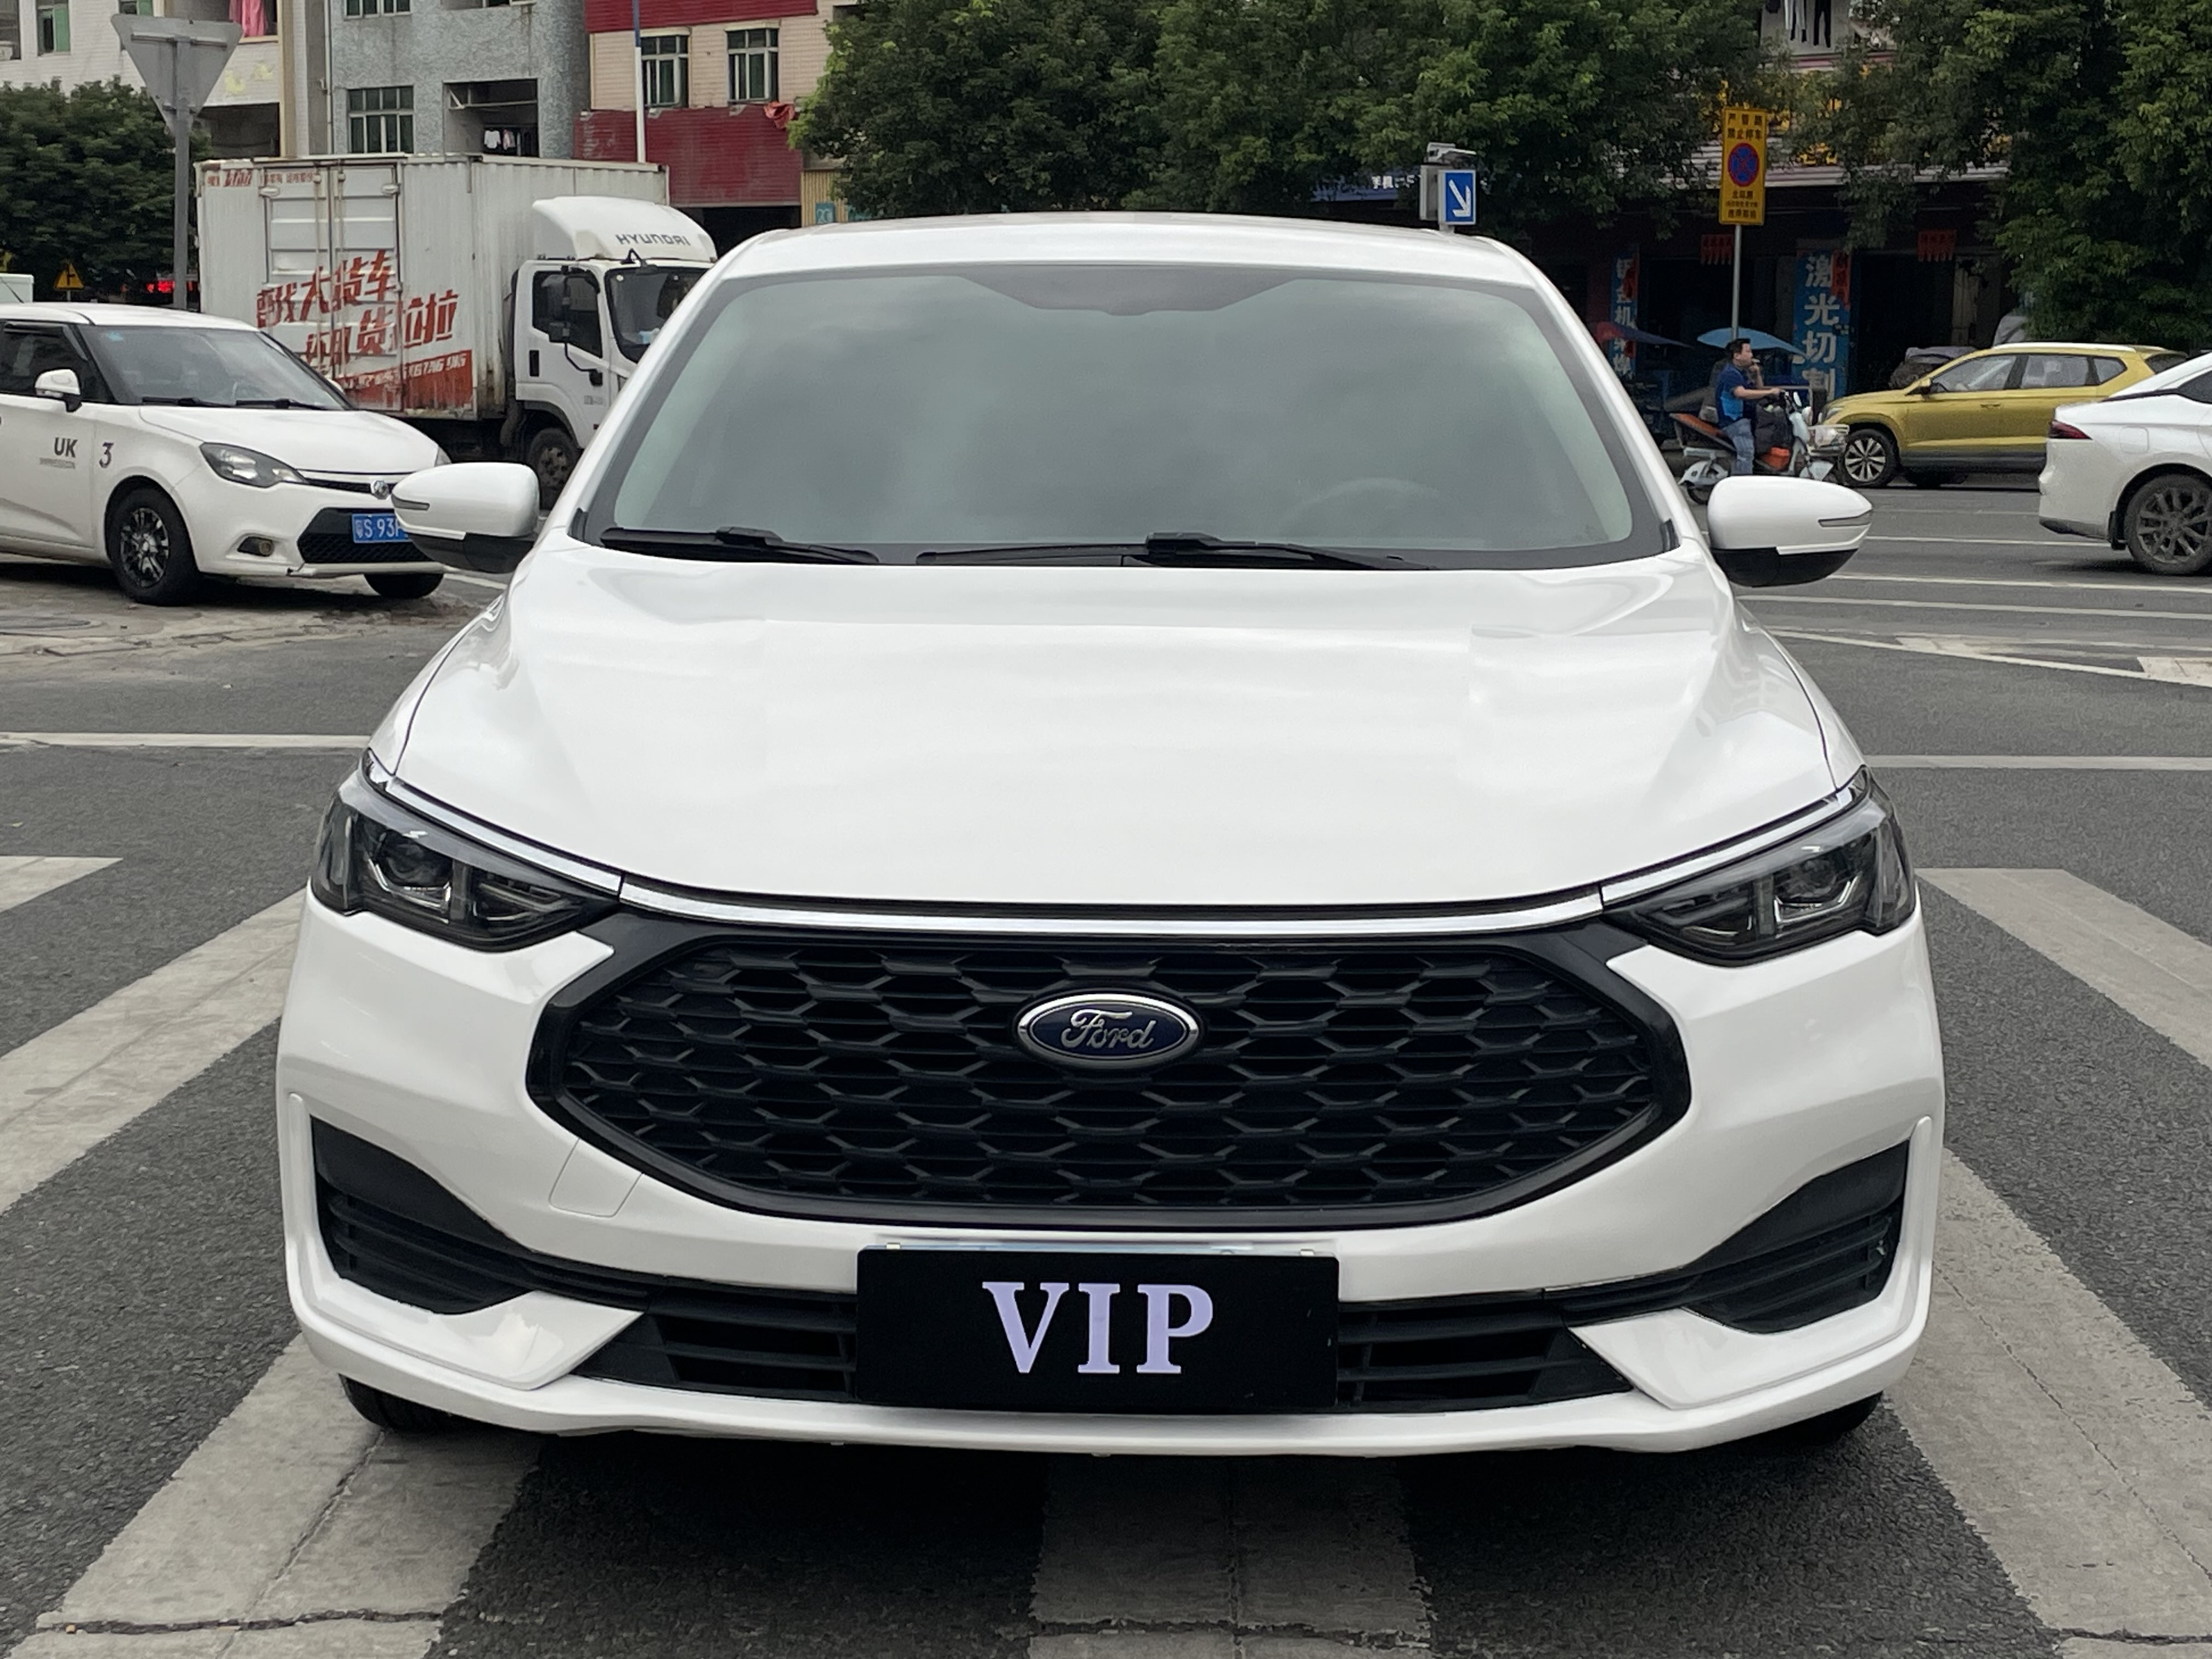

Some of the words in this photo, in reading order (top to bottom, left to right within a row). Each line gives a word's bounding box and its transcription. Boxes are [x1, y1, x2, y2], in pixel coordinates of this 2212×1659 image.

[615, 234, 691, 246] HYUNDAI
[54, 437, 78, 458] UK
[99, 442, 114, 469] 3
[1061, 1009, 1156, 1048] Ford
[982, 1281, 1214, 1374] VIP
